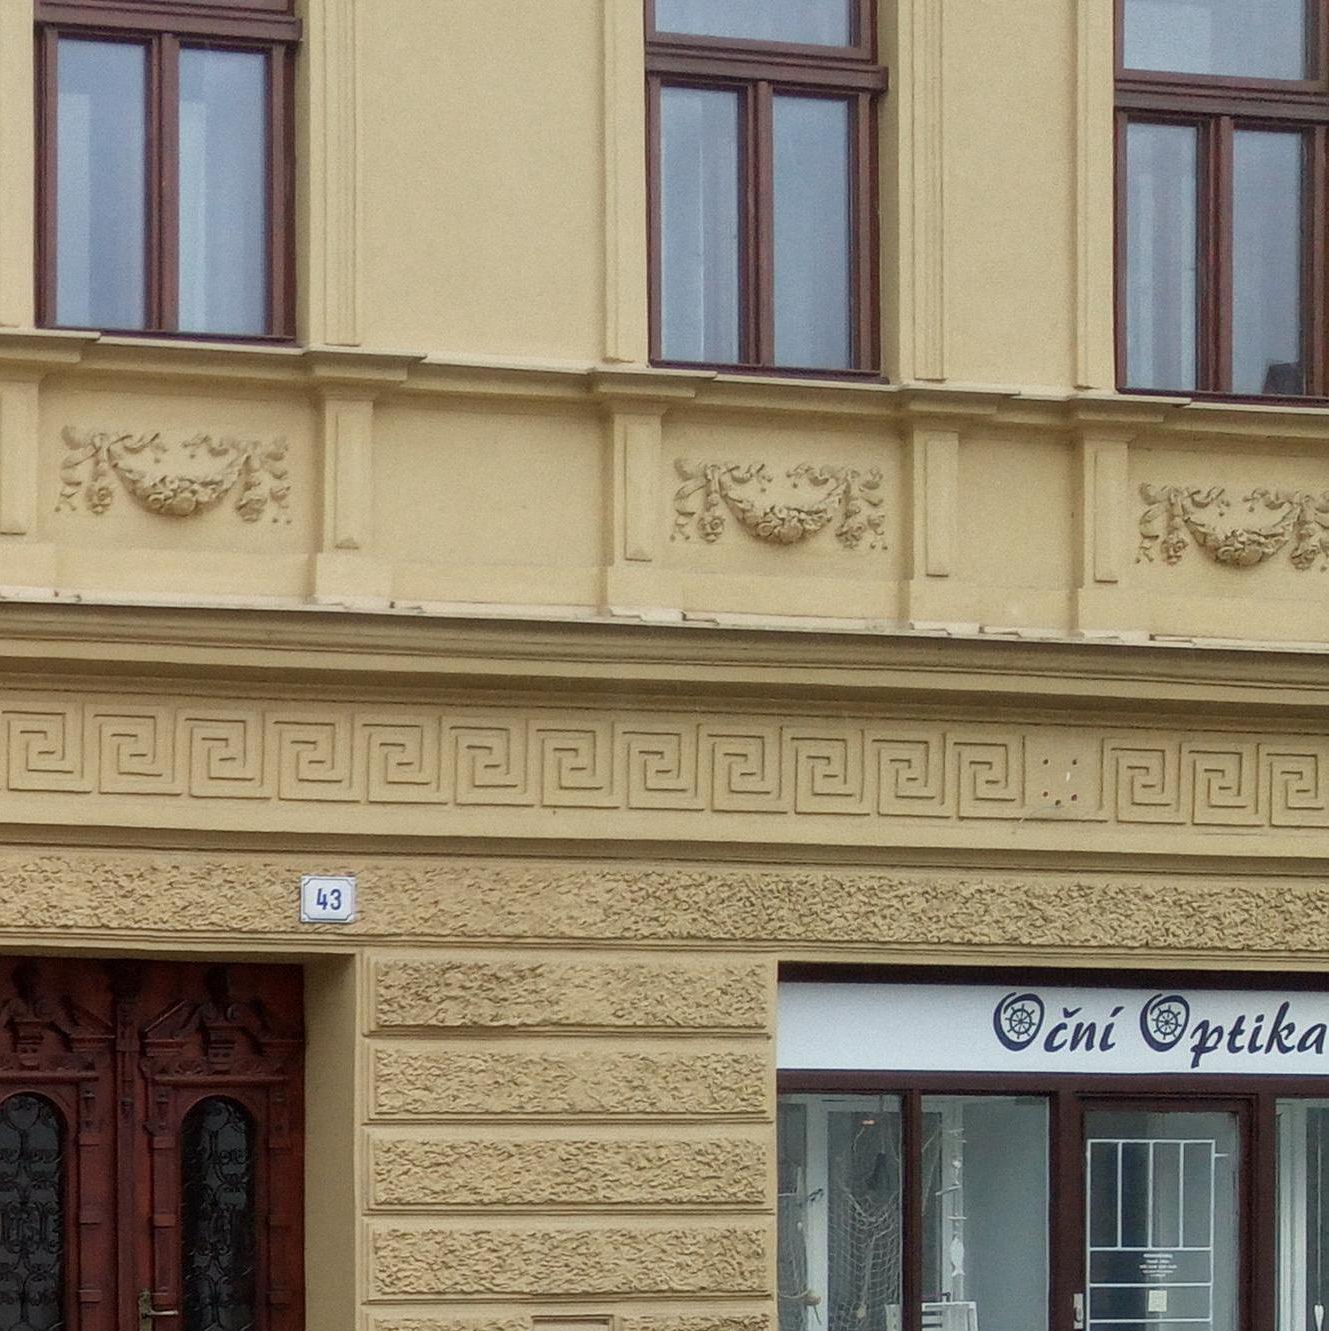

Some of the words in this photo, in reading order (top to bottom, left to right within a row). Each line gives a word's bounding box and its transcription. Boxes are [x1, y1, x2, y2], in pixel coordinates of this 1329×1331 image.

[316, 888, 342, 911] 43
[993, 992, 1125, 1053] Oční
[1139, 993, 1328, 1069] Optika
